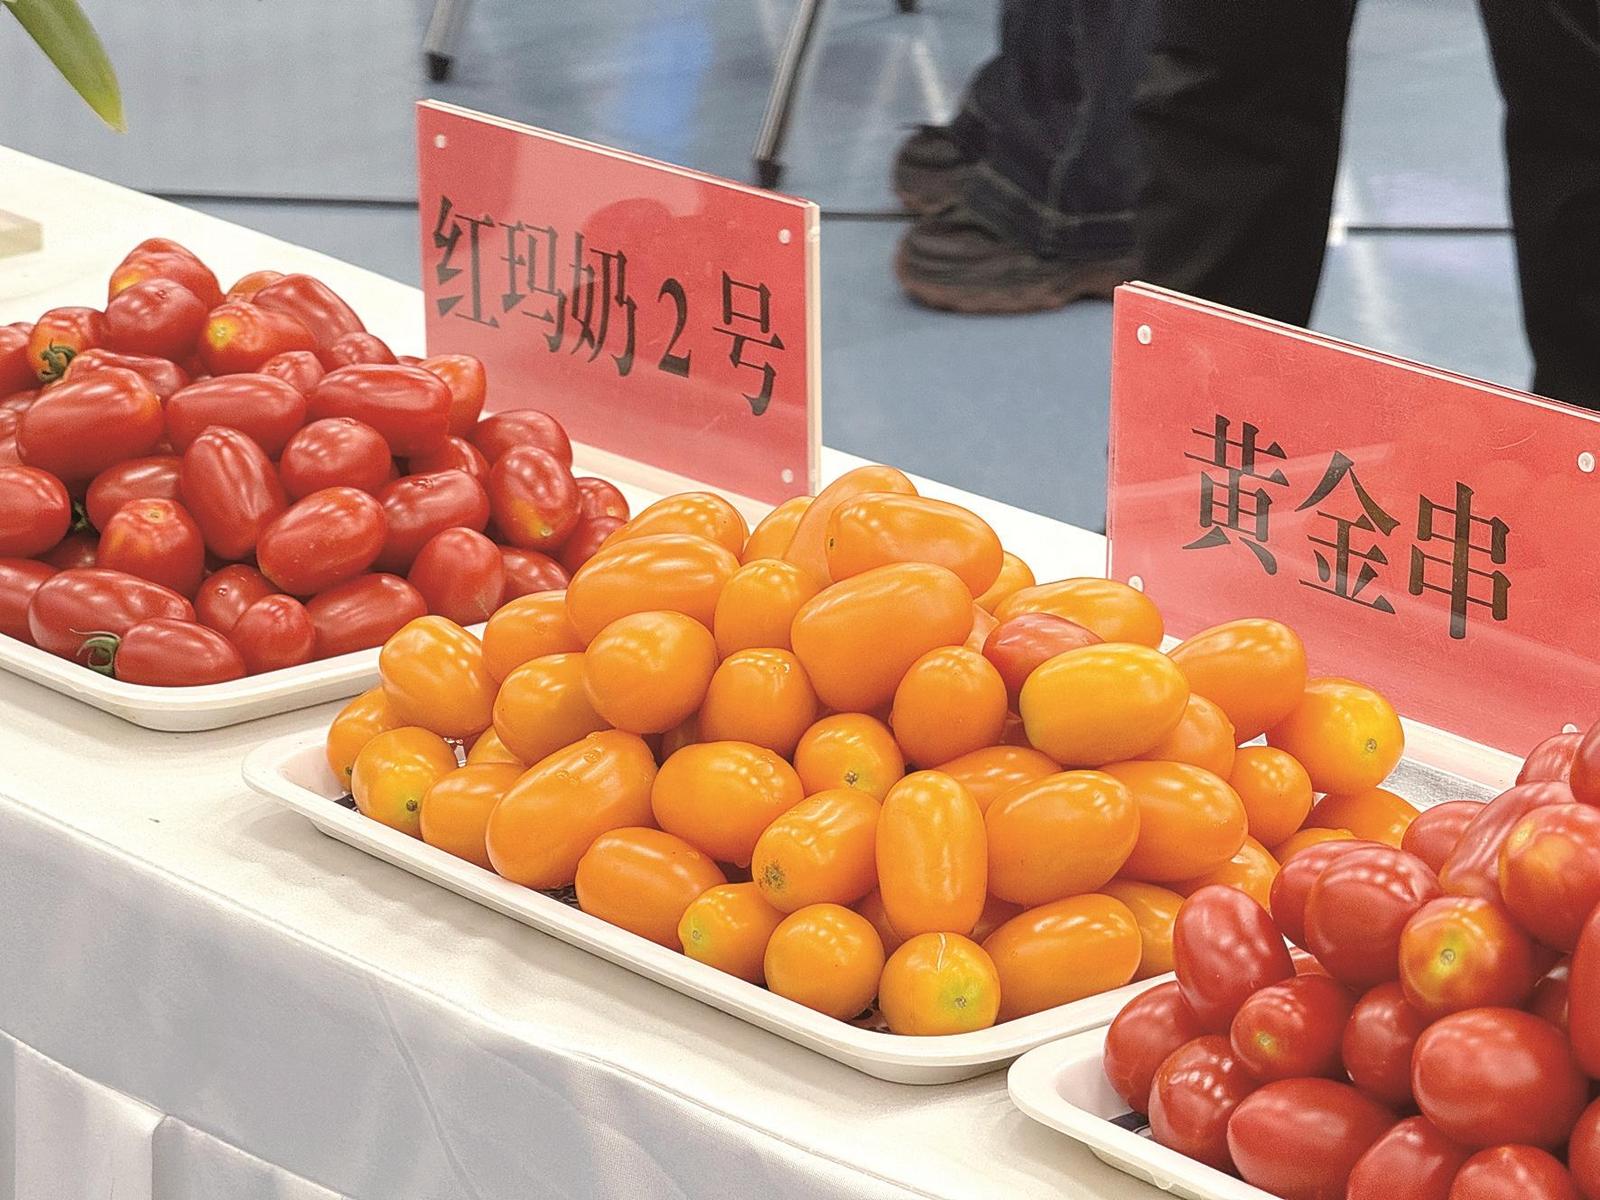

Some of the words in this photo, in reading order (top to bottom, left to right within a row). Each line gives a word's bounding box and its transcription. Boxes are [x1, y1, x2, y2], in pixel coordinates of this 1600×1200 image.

[433, 195, 785, 416] 红玛奶2号
[1182, 413, 1511, 640] 黄金串
